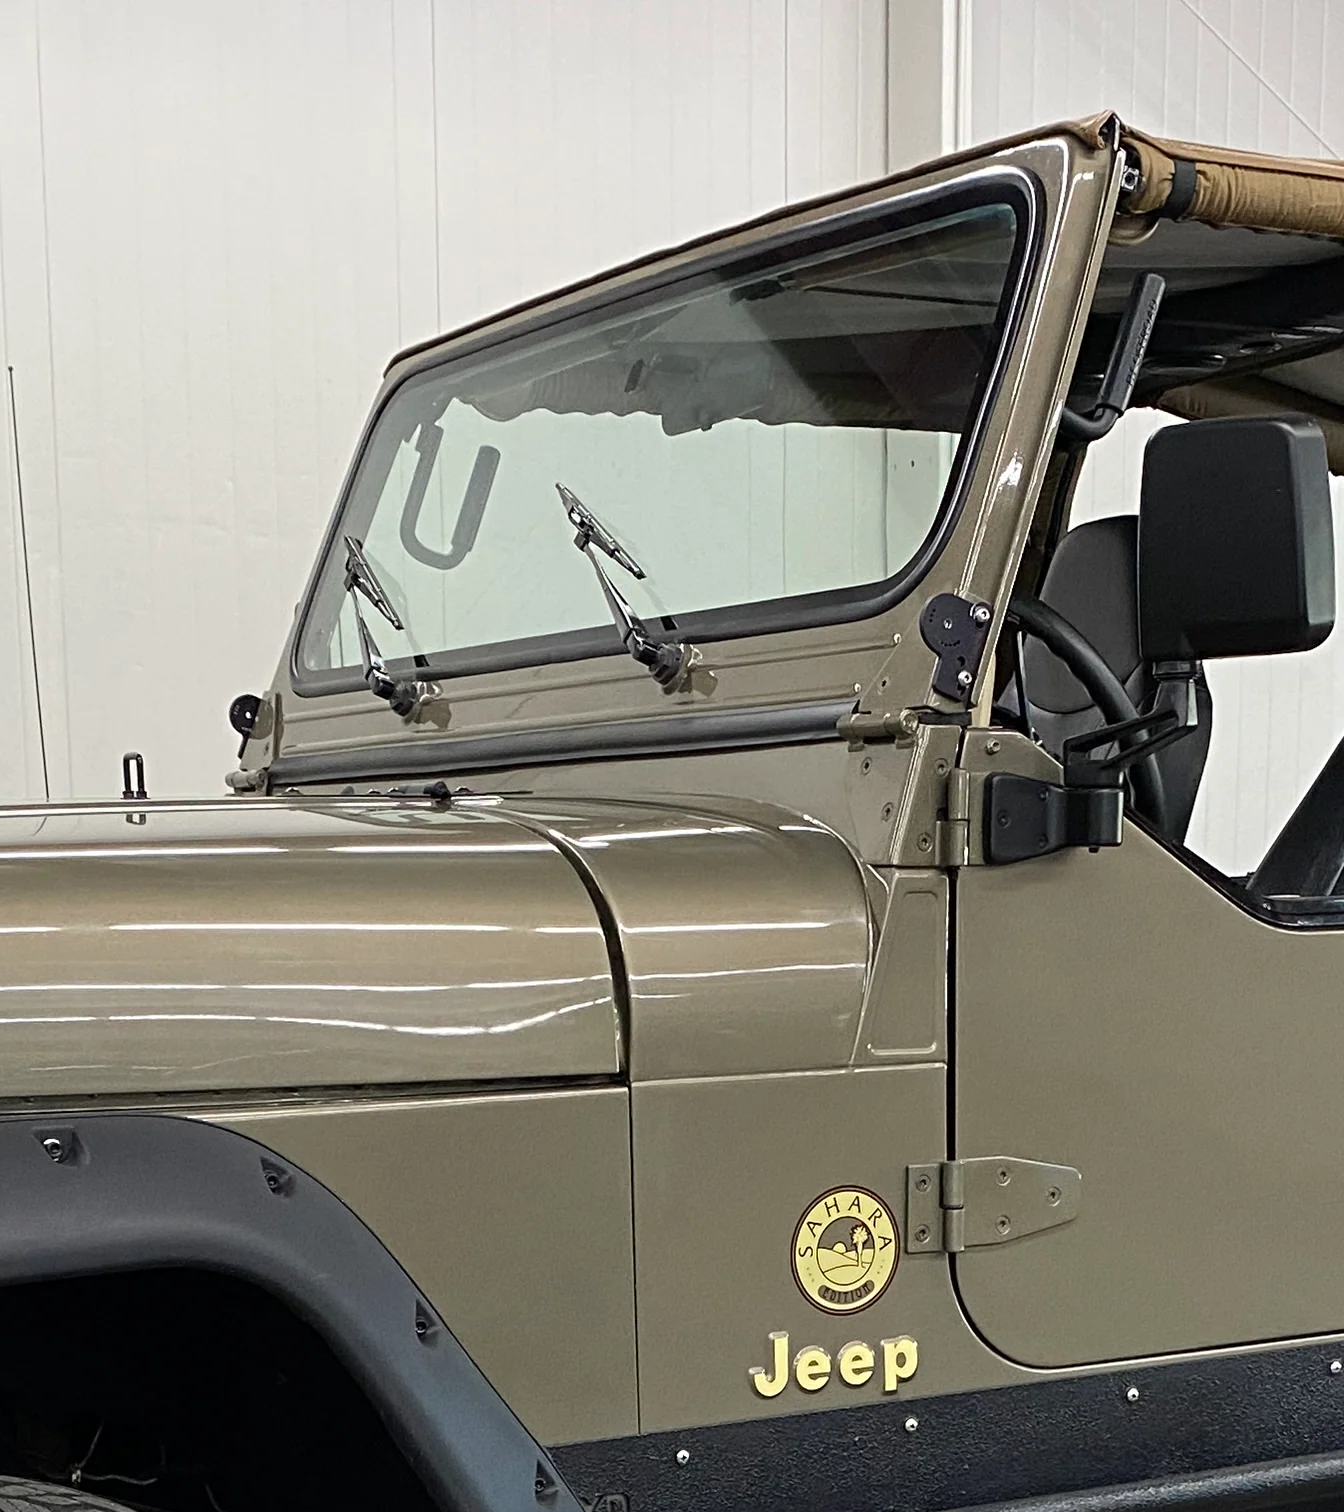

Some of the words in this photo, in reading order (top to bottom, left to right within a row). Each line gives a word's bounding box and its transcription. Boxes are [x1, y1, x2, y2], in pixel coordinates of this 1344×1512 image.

[799, 1195, 893, 1258] SAHARA
[820, 1282, 872, 1302] EDITION
[749, 1331, 919, 1398] Jeep
